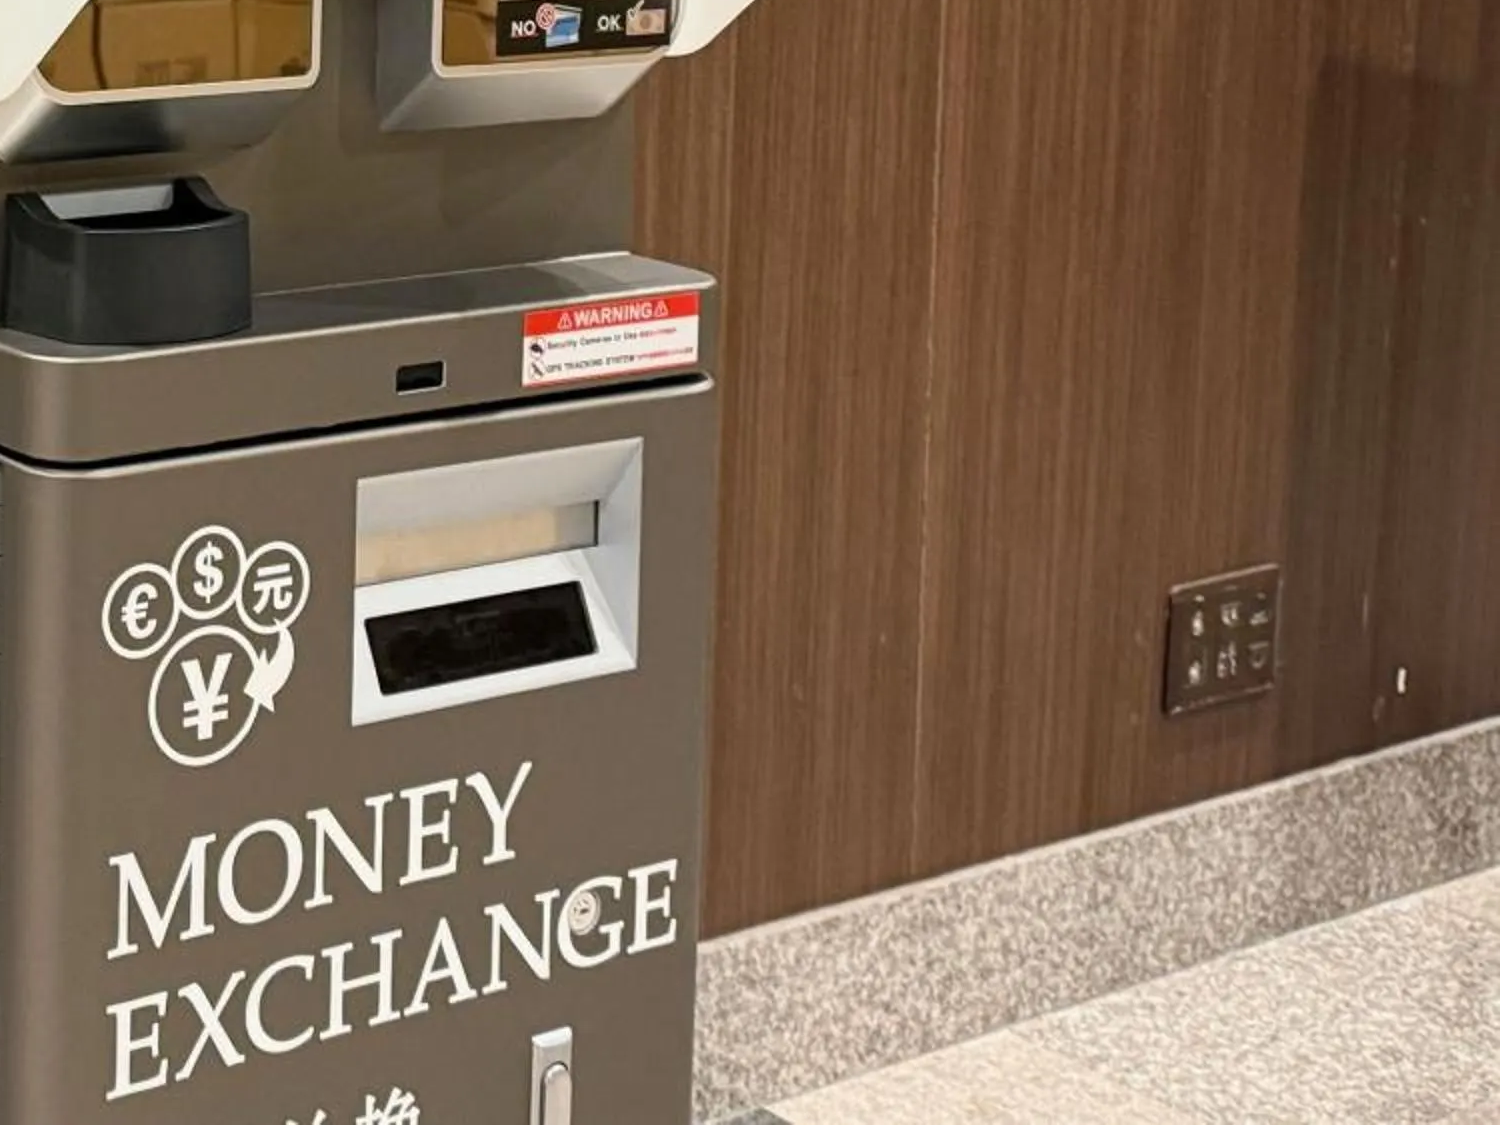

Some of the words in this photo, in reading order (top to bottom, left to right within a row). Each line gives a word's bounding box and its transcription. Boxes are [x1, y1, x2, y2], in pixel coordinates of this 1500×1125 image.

[511, 20, 536, 38] NO
[597, 14, 621, 31] OK
[572, 301, 653, 327] WARNING
[253, 562, 293, 614] 元
[106, 761, 533, 960] MONEY
[105, 858, 678, 1101] EXCHANGE
